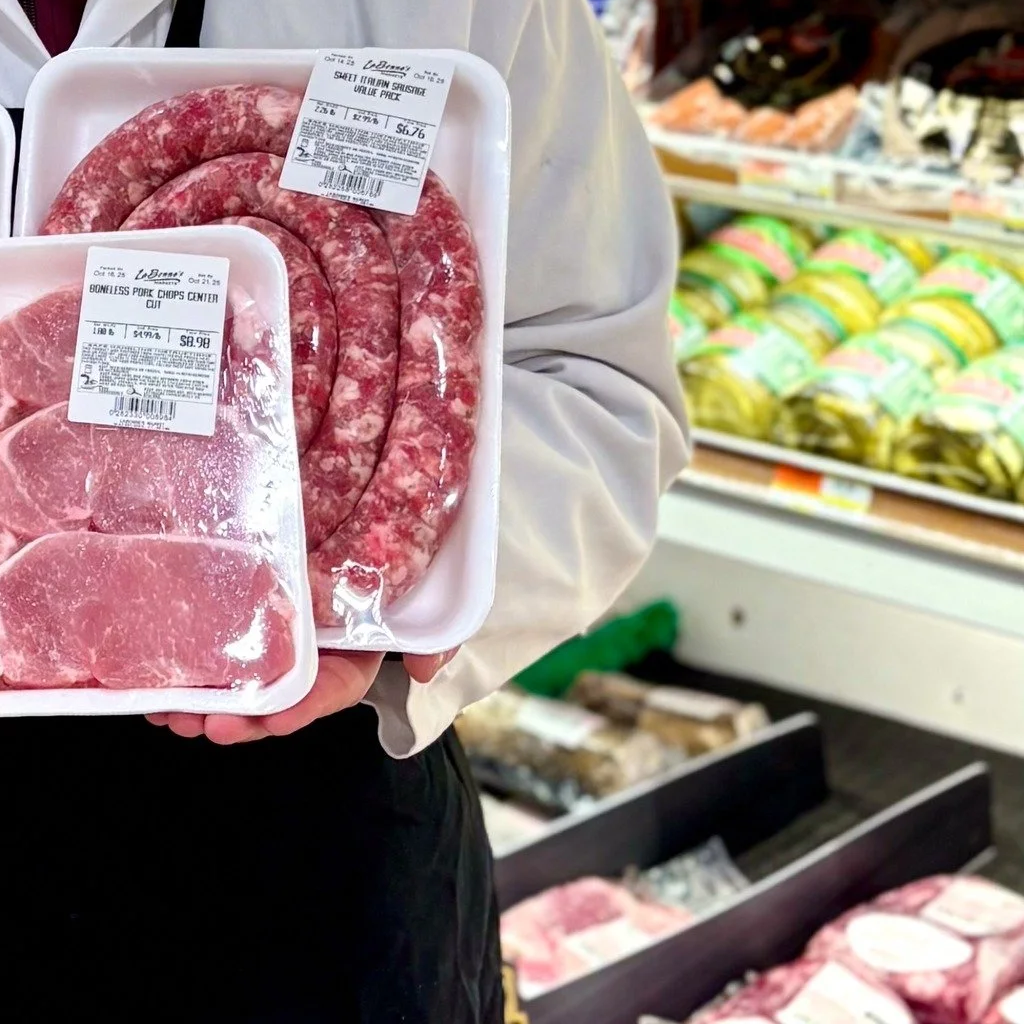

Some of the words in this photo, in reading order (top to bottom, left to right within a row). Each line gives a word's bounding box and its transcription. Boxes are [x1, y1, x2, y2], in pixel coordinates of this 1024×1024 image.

[333, 71, 357, 83] SWEET
[360, 75, 390, 89] ITALIAN
[392, 82, 426, 97] SAUSAGE
[354, 85, 378, 98] VALUE
[380, 90, 402, 102] PACK
[396, 123, 425, 139] $6.76
[89, 283, 130, 296] BONELESS
[132, 287, 155, 298] PORK
[157, 289, 185, 301] CHOPS
[187, 291, 219, 304] CENTER
[146, 299, 161, 309] CUT
[179, 335, 211, 349] $8.98
